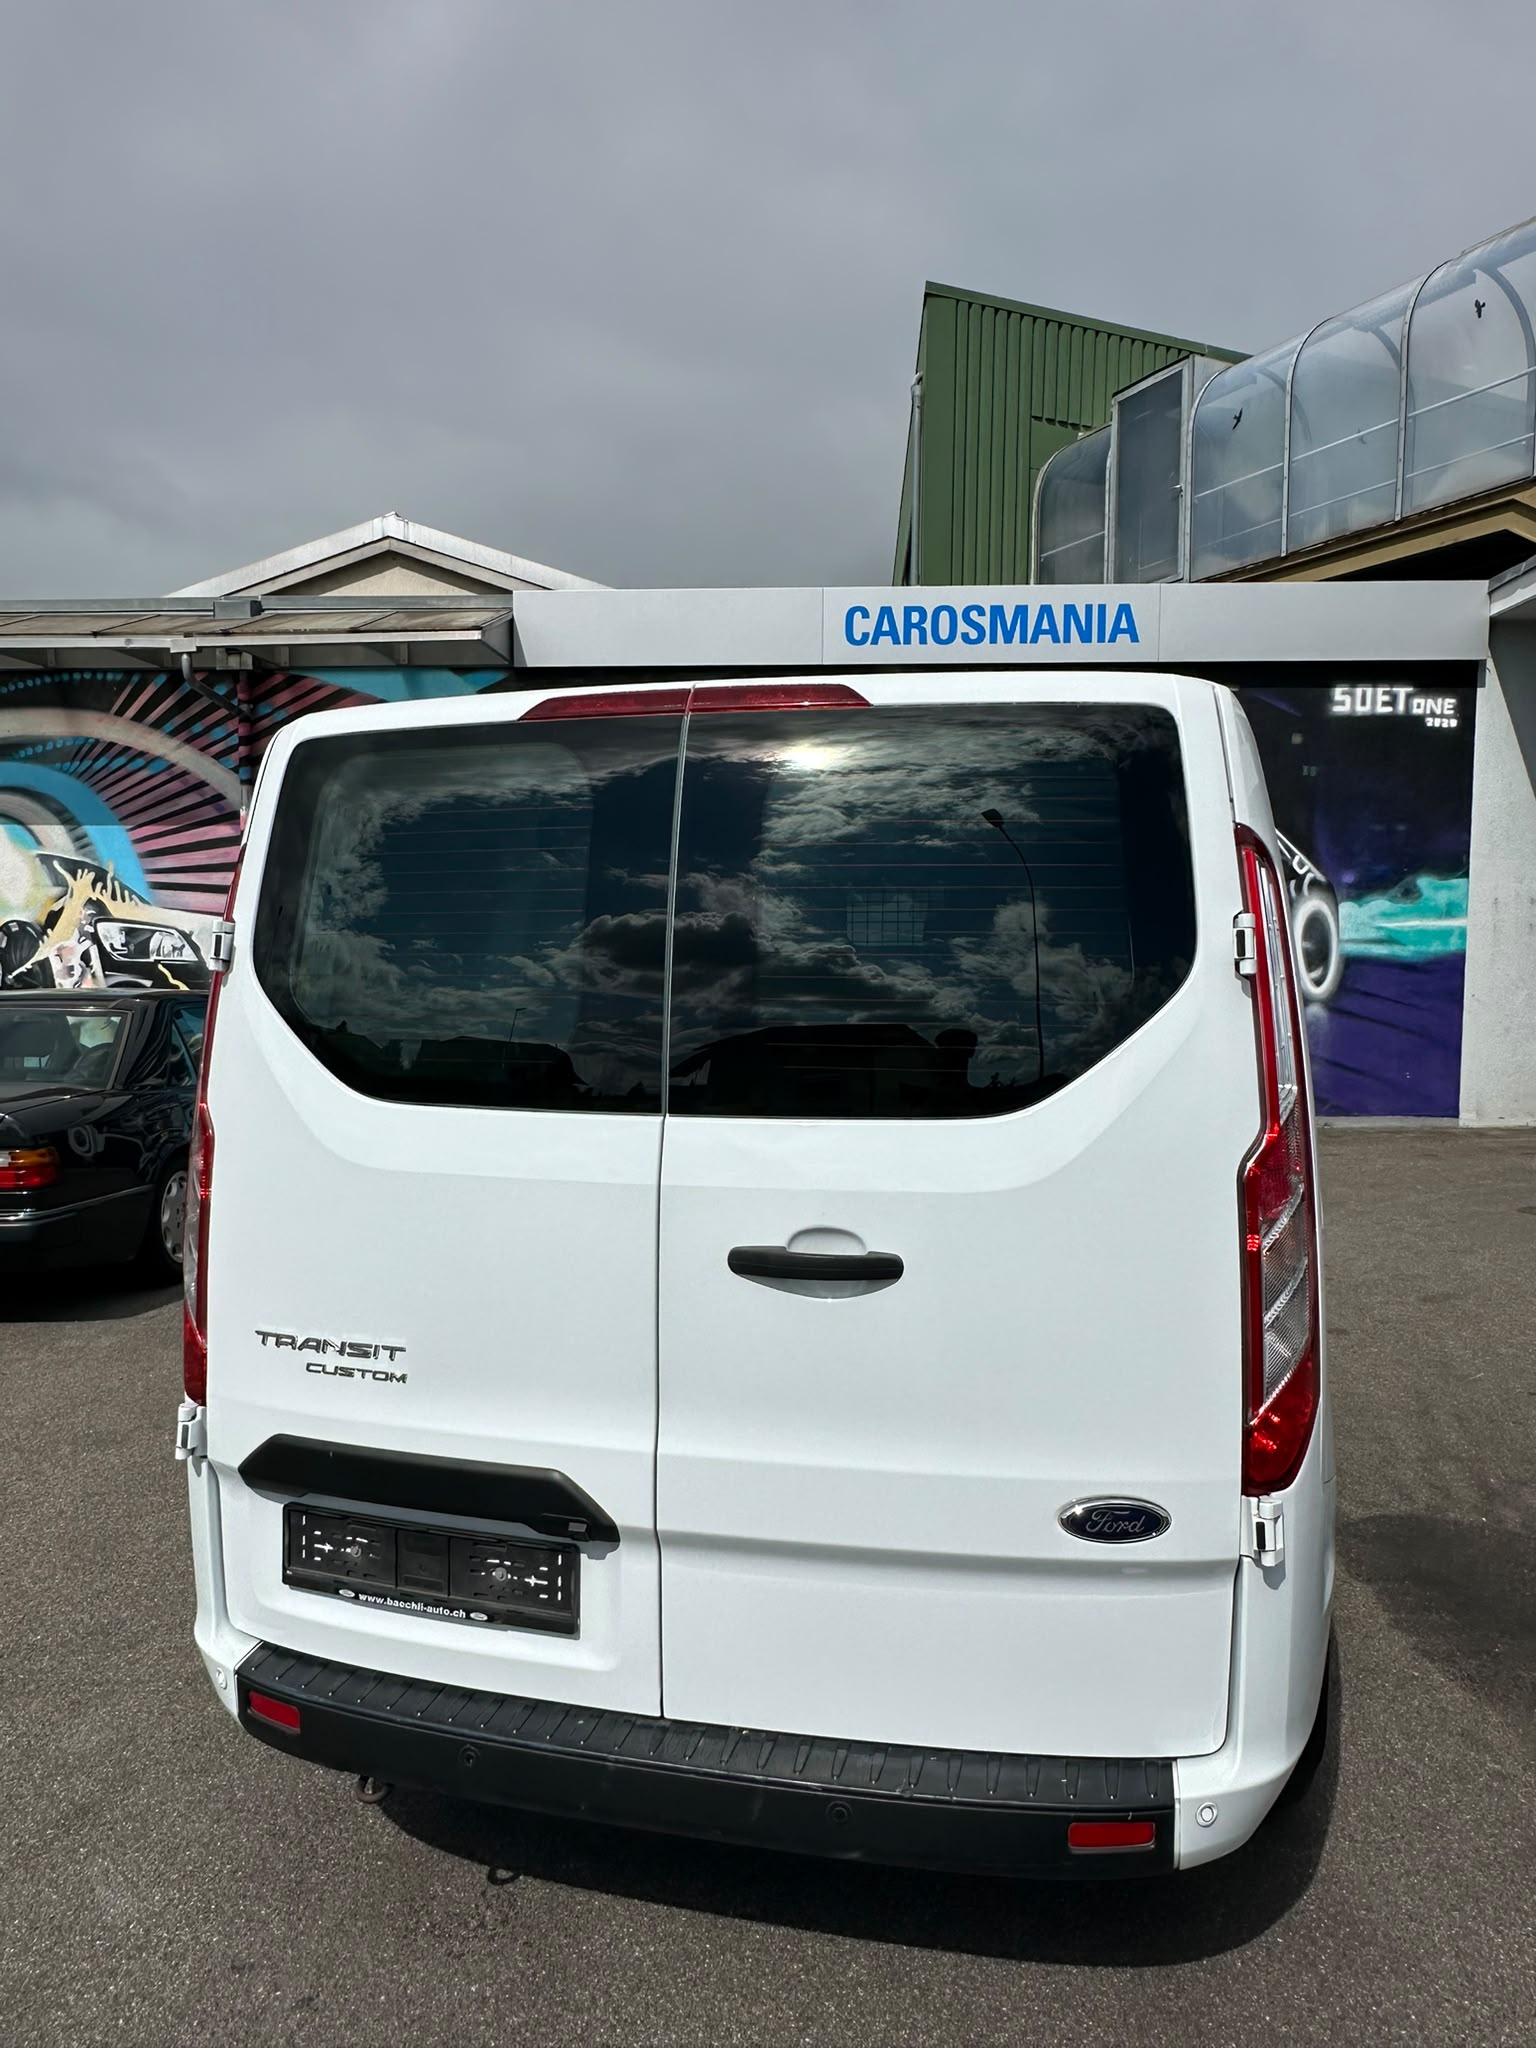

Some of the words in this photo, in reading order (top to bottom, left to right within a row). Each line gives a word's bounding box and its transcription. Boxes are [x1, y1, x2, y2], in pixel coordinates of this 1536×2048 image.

[844, 602, 1139, 646] CAROSMANIA
[254, 1330, 407, 1362] TRANSIT
[305, 1362, 408, 1384] CUSTOM
[1085, 1508, 1145, 1533] Ford
